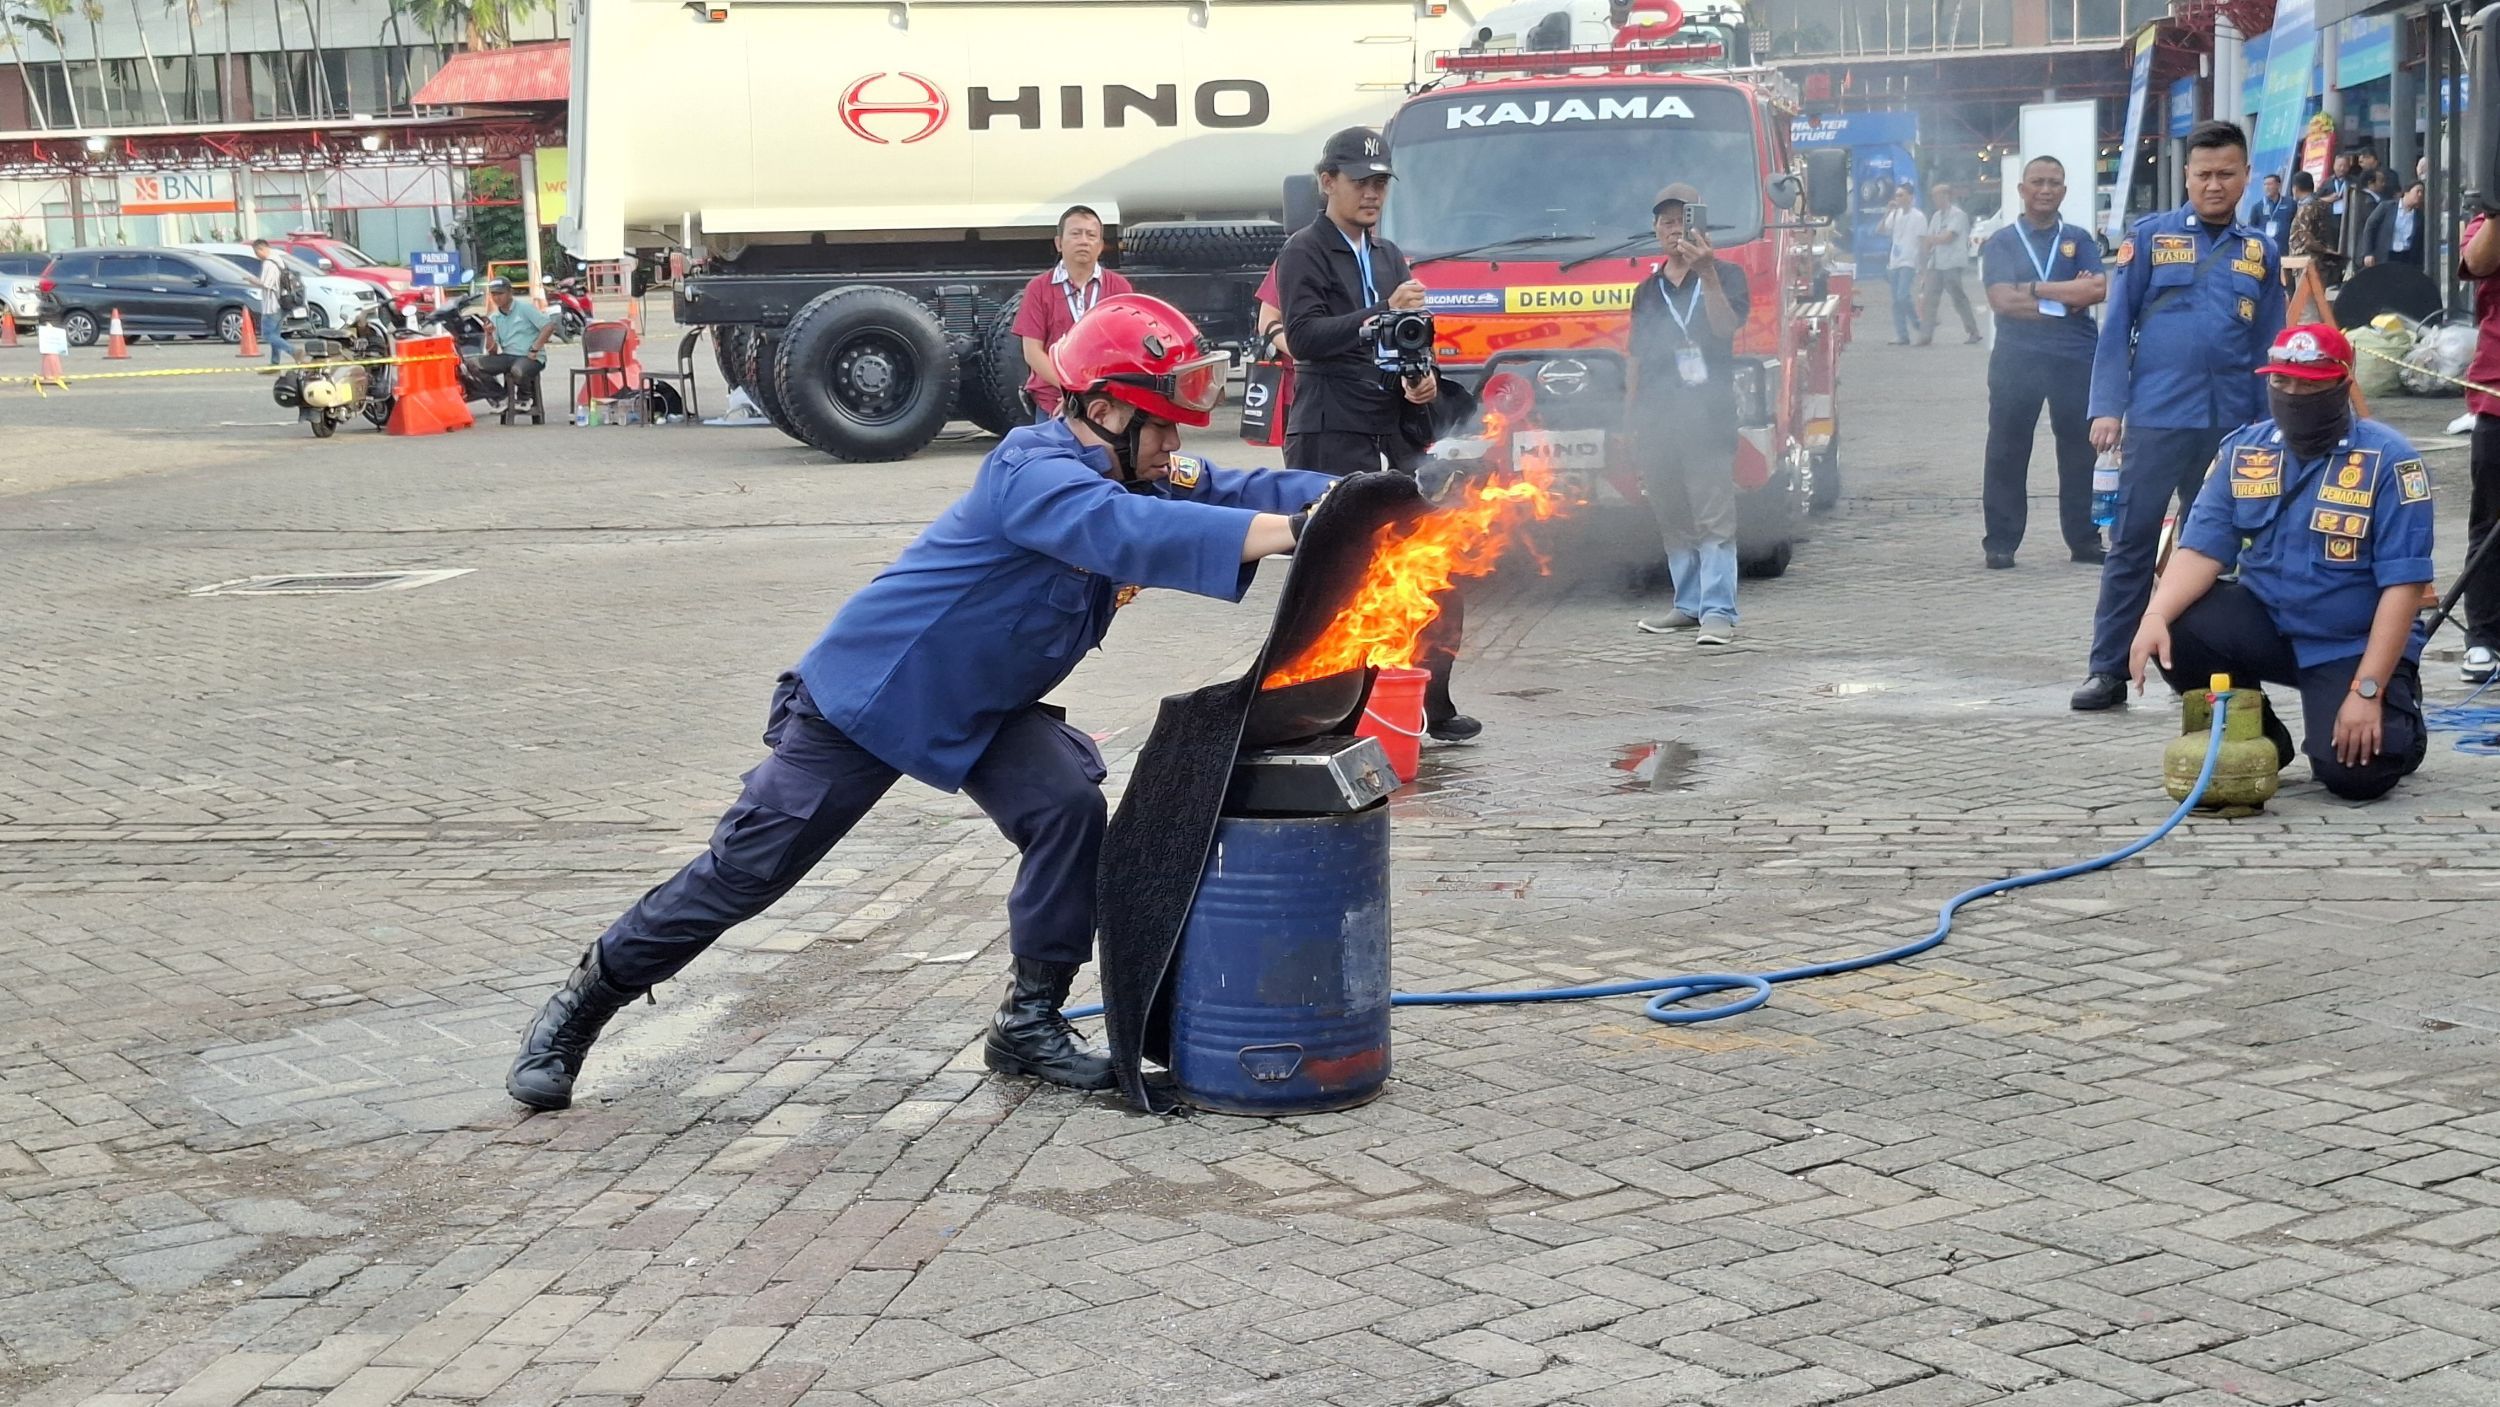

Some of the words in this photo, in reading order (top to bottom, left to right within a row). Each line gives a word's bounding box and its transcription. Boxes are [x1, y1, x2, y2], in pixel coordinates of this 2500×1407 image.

[968, 79, 1270, 130] HINO
[1446, 96, 1695, 130] KAJAMA
[1791, 130, 1837, 141] UTURE
[163, 175, 214, 200] BNI
[1520, 291, 1583, 307] DEMO
[1592, 288, 1631, 305] UNI
[1520, 442, 1600, 458] HINO
